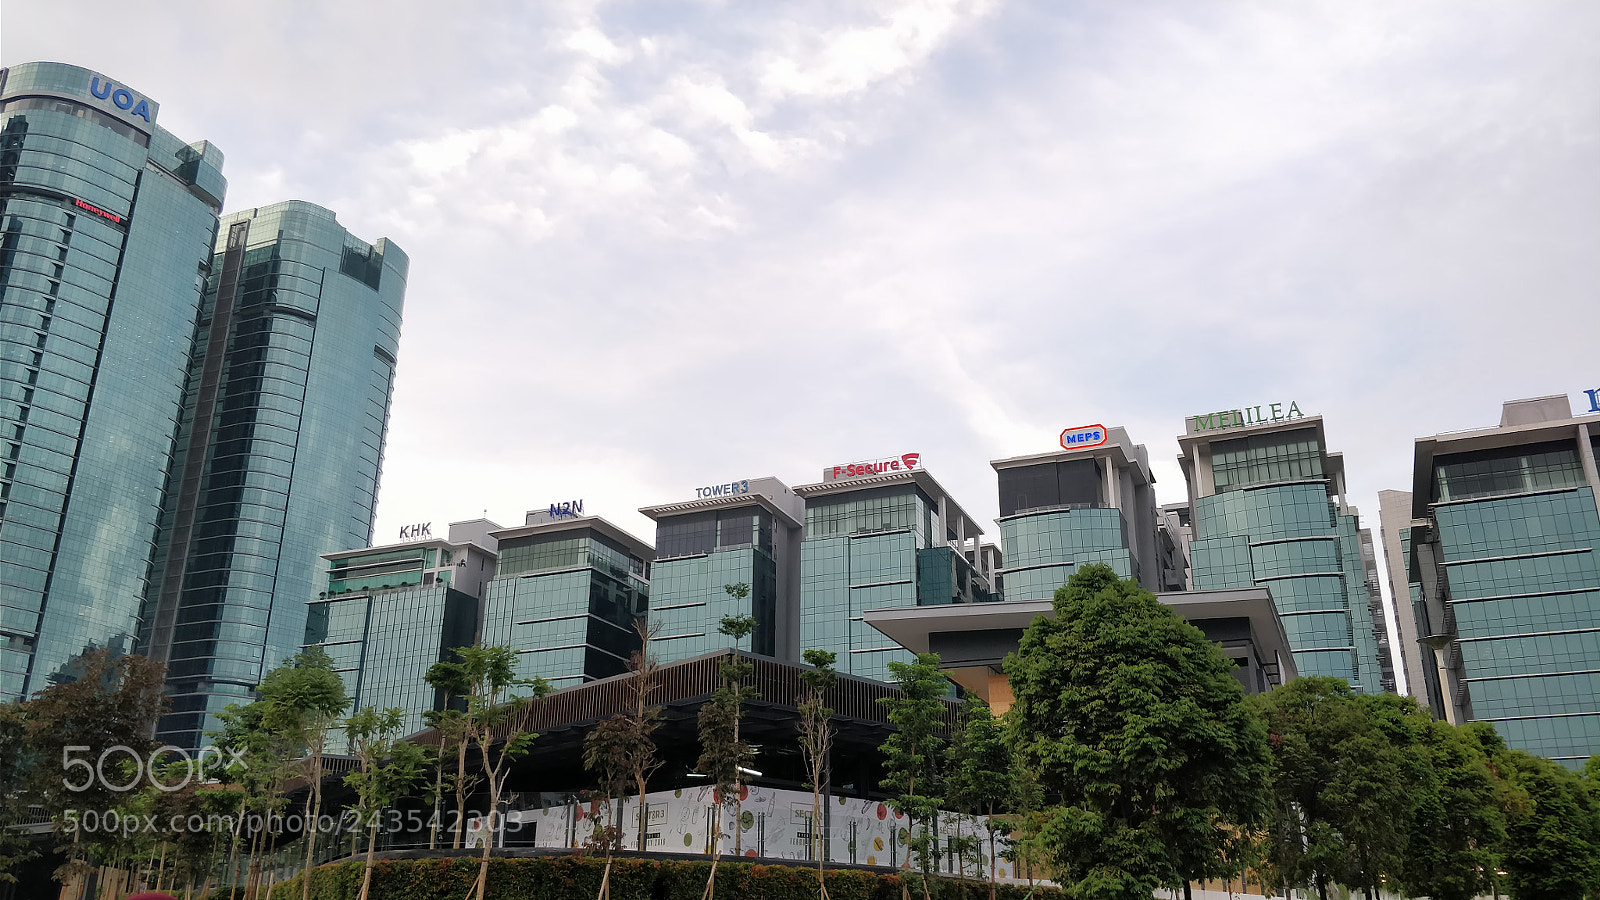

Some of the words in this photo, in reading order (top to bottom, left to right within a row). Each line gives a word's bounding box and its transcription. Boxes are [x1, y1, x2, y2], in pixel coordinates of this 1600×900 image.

[91, 77, 150, 122] UOA
[75, 198, 120, 224] Honeywell
[1194, 400, 1304, 432] MELILEA
[1066, 431, 1100, 444] MEPS
[833, 458, 900, 479] F-Secure
[696, 482, 740, 498] TOWER
[740, 480, 749, 493] 3
[550, 499, 583, 516] N2N
[400, 522, 431, 538] KHK
